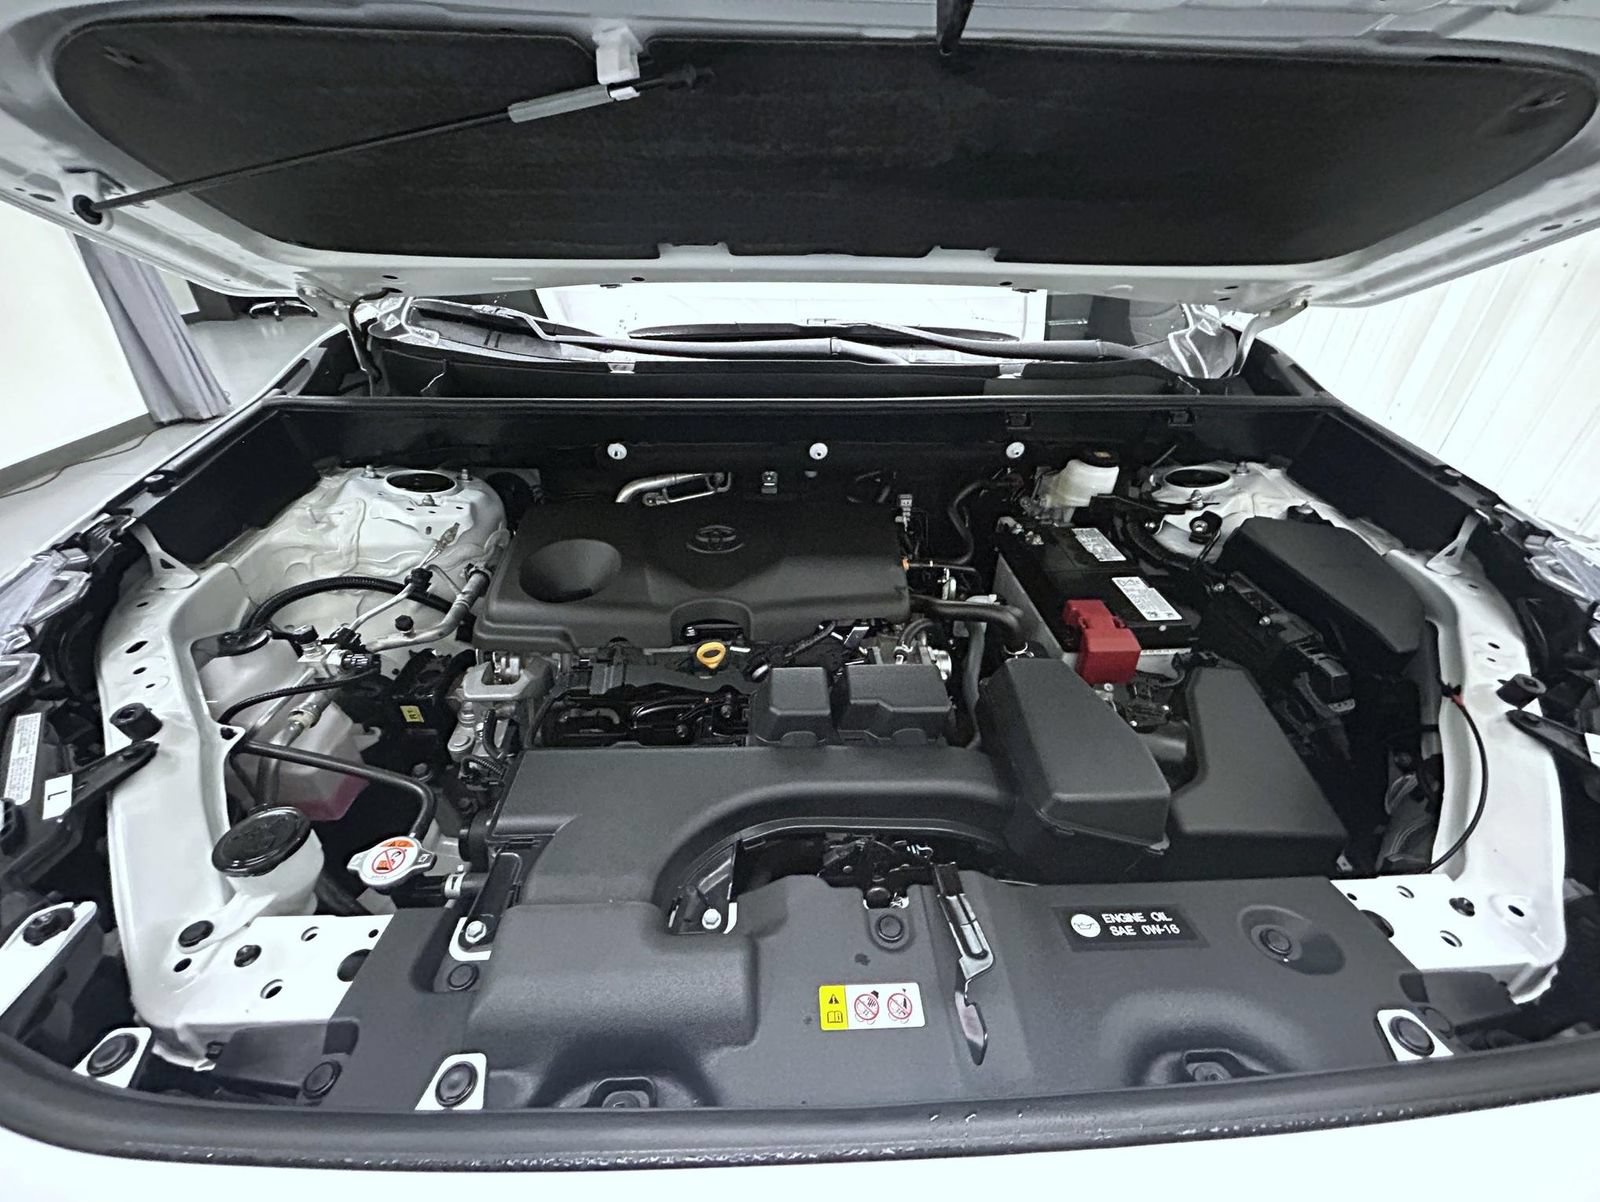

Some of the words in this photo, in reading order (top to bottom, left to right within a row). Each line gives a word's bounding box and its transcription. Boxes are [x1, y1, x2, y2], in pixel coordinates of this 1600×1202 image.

[1101, 912, 1146, 924] ENGINE
[1150, 911, 1173, 922] OIL
[1109, 925, 1137, 936] SAE
[1141, 923, 1180, 935] 0W-16
